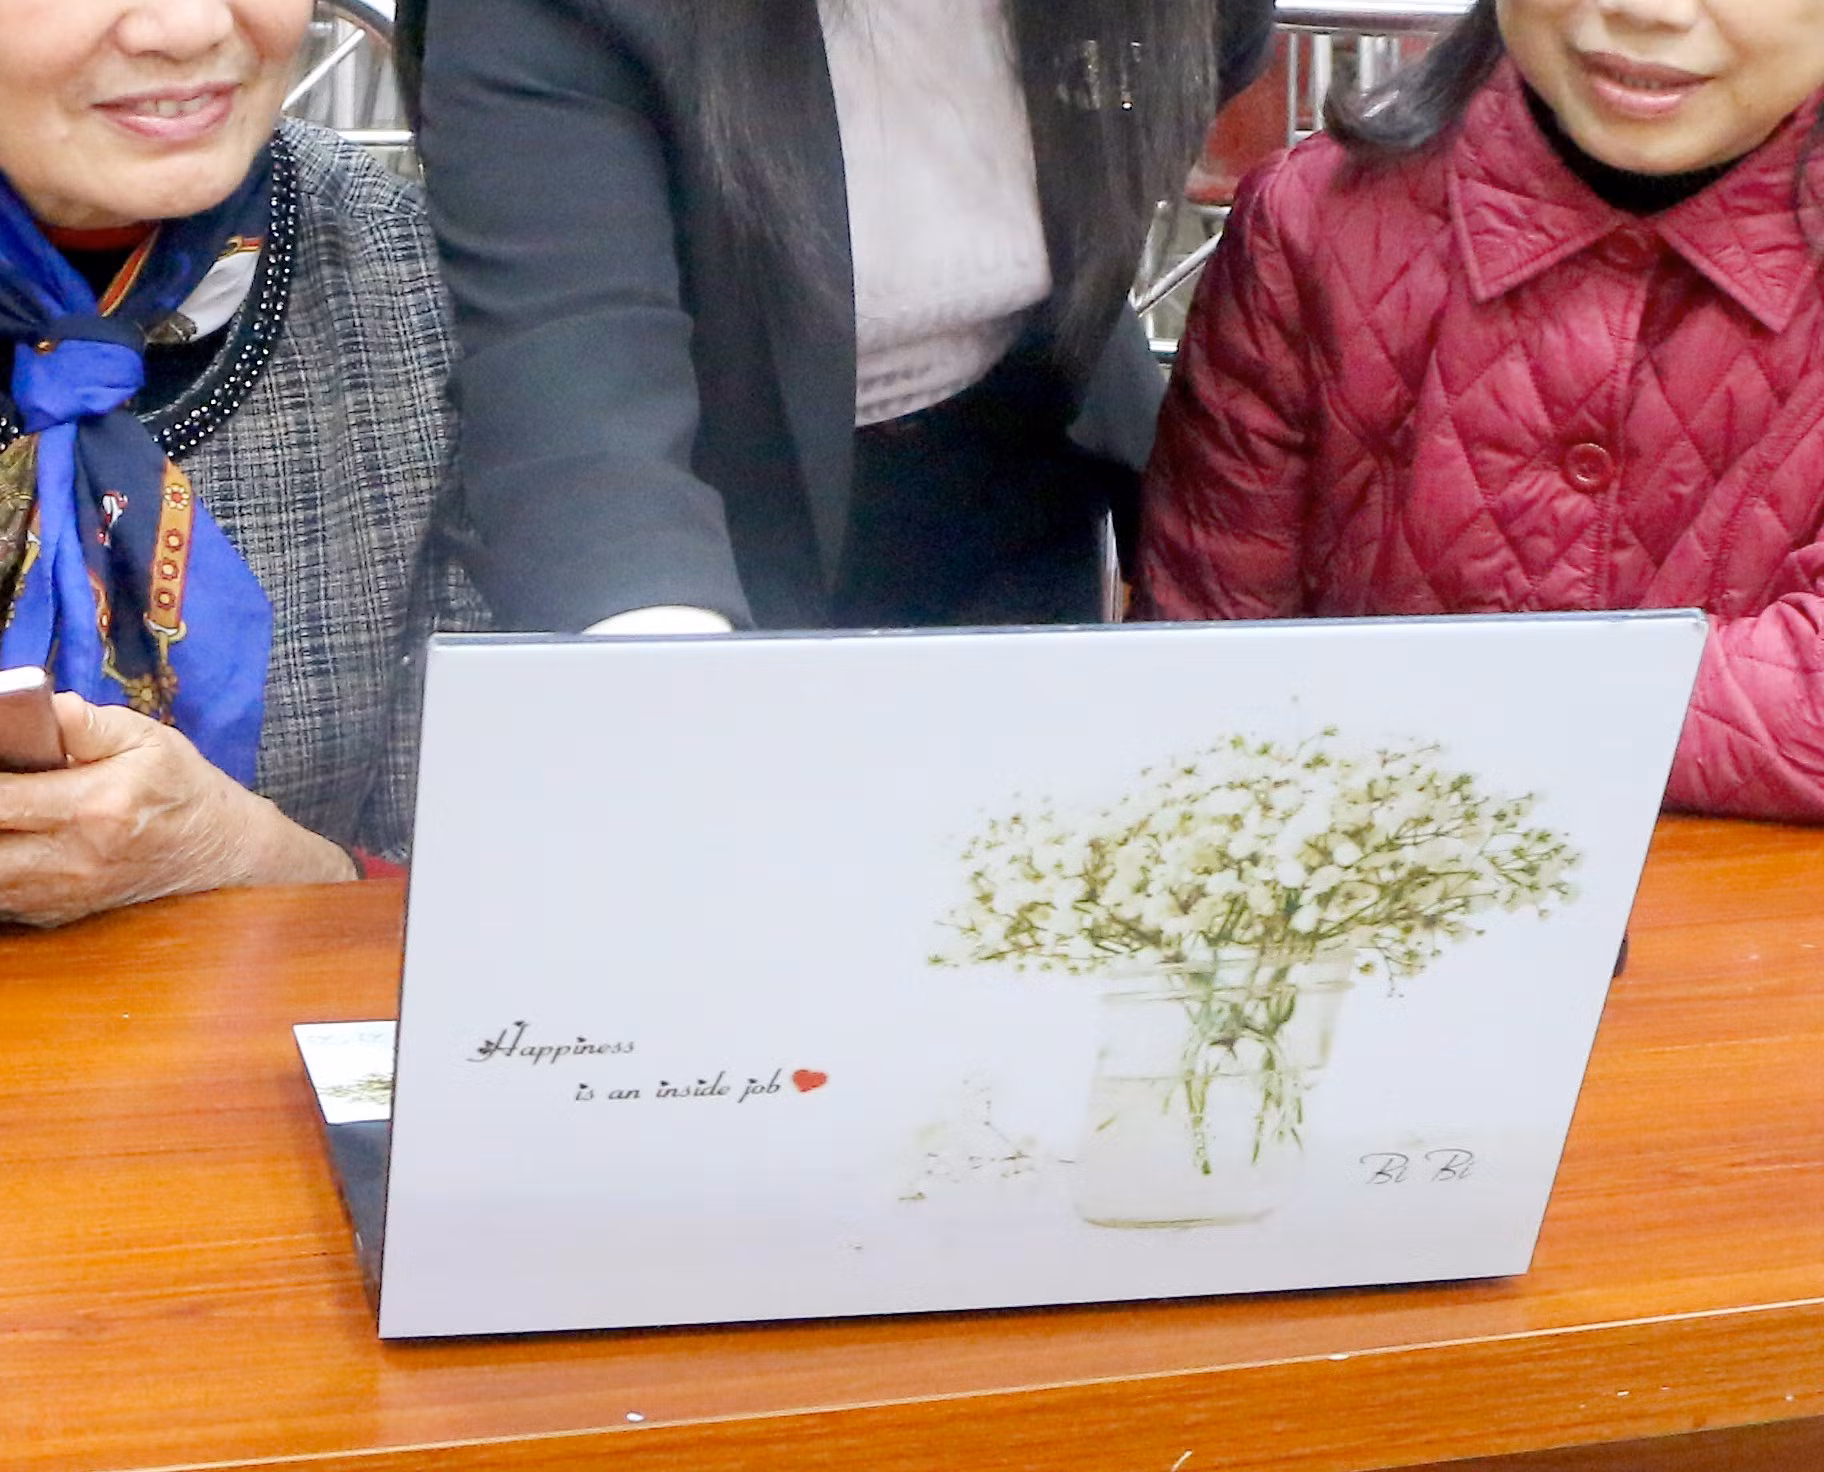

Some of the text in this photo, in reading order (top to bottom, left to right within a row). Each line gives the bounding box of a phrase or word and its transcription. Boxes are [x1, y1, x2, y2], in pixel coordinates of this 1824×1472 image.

[466, 1020, 636, 1065] Happiness
[575, 1068, 783, 1103] is an inside job
